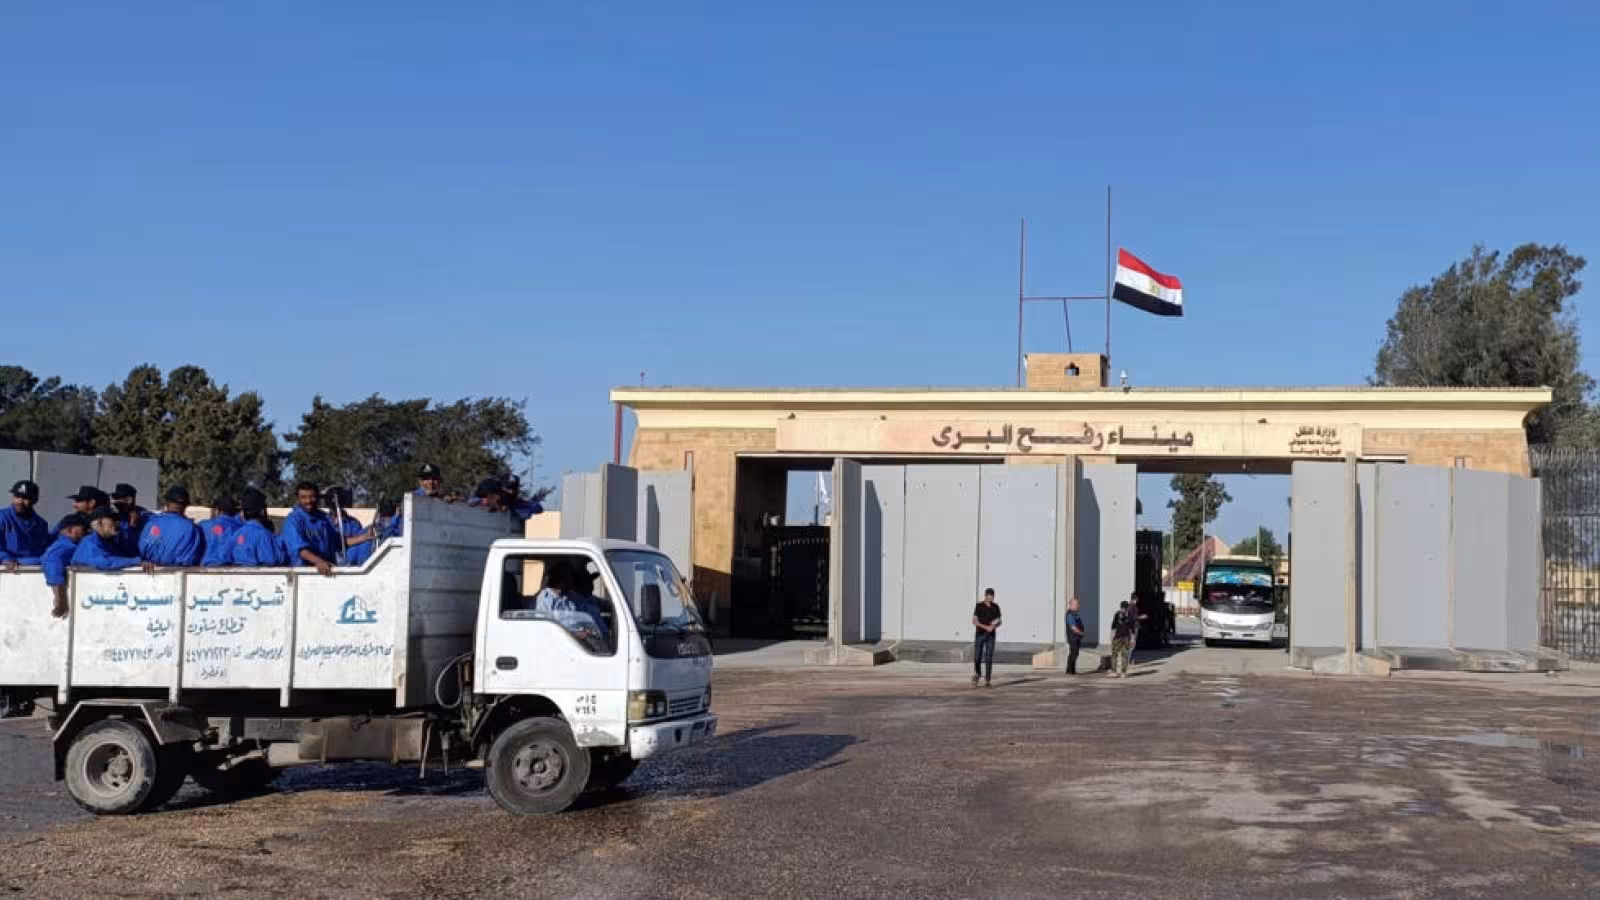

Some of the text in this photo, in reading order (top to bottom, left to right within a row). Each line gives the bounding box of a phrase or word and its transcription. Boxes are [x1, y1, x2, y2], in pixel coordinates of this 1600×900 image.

[1016, 422, 1104, 452] رفح
[1106, 423, 1195, 452] ميناء
[186, 587, 231, 612] كير
[232, 585, 285, 611] شركة
[216, 617, 247, 635] قطاع
